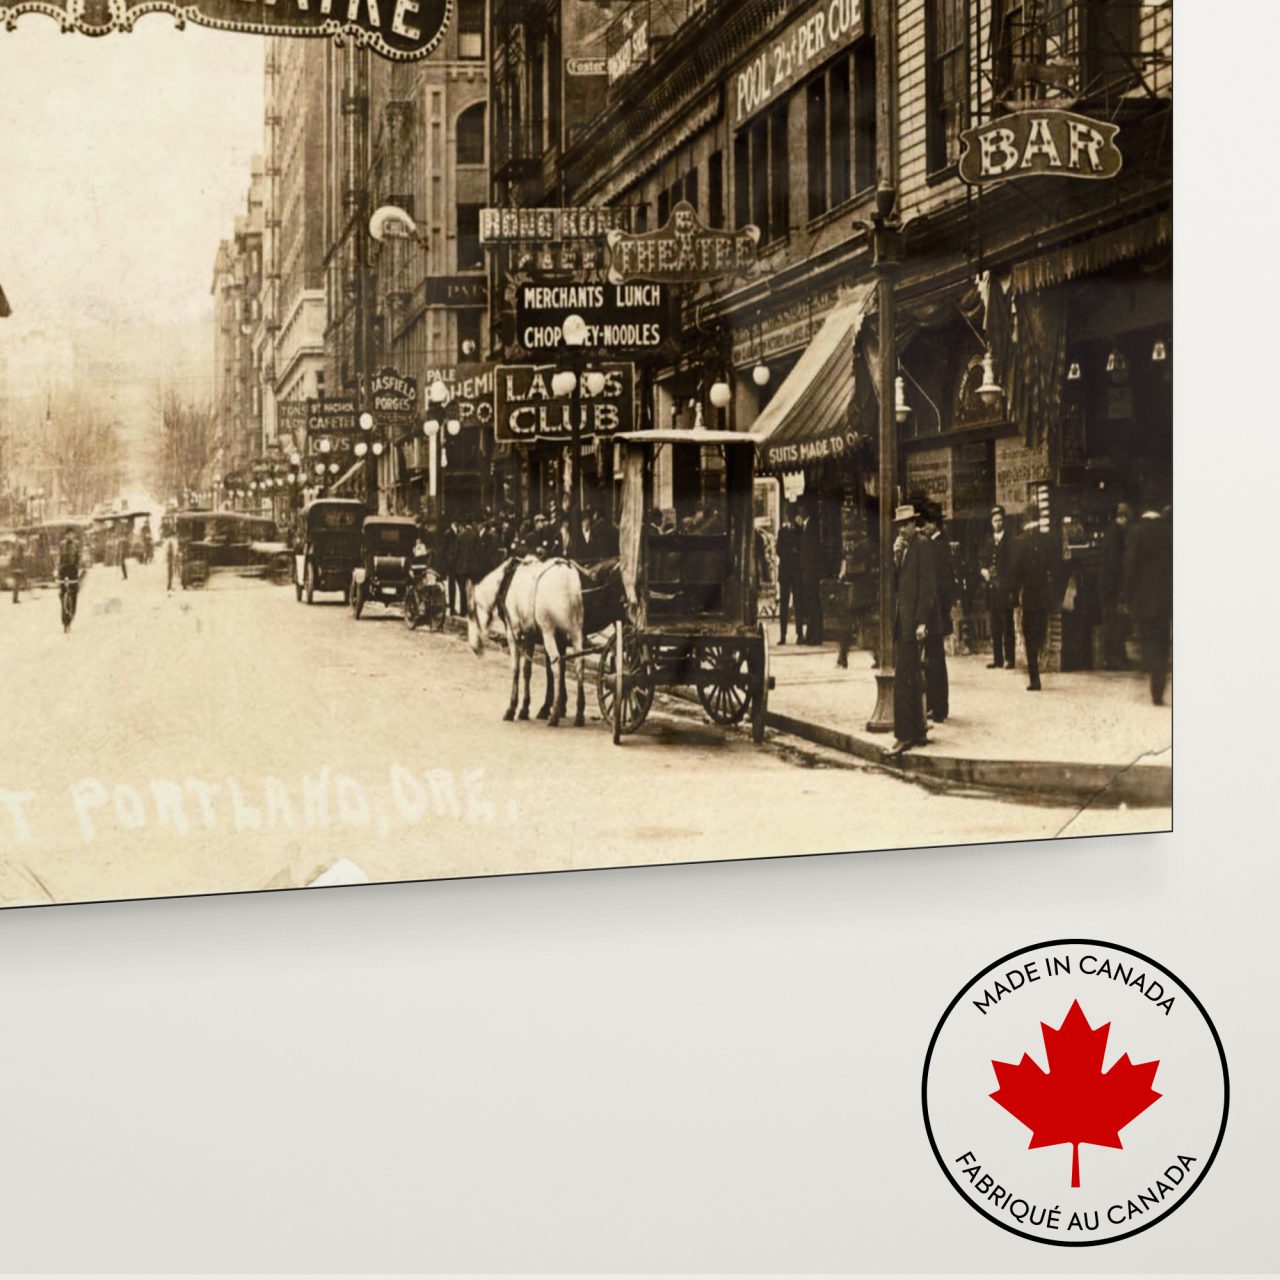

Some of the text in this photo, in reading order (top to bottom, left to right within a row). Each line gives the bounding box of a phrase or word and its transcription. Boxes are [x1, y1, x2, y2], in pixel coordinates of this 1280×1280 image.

[571, 60, 606, 73] Foster
[737, 53, 771, 121] POOL
[798, 11, 826, 66] PER
[978, 119, 1105, 176] BAR
[620, 232, 756, 273] THEATRE
[524, 284, 661, 309] MERCHANTS LUNCH
[524, 325, 562, 348] CHOP
[426, 369, 457, 382] PALE
[506, 371, 624, 401] LAS
[509, 404, 620, 433] CLUB
[769, 444, 798, 464] SUITS
[800, 439, 829, 460] MADE
[830, 435, 844, 453] TO
